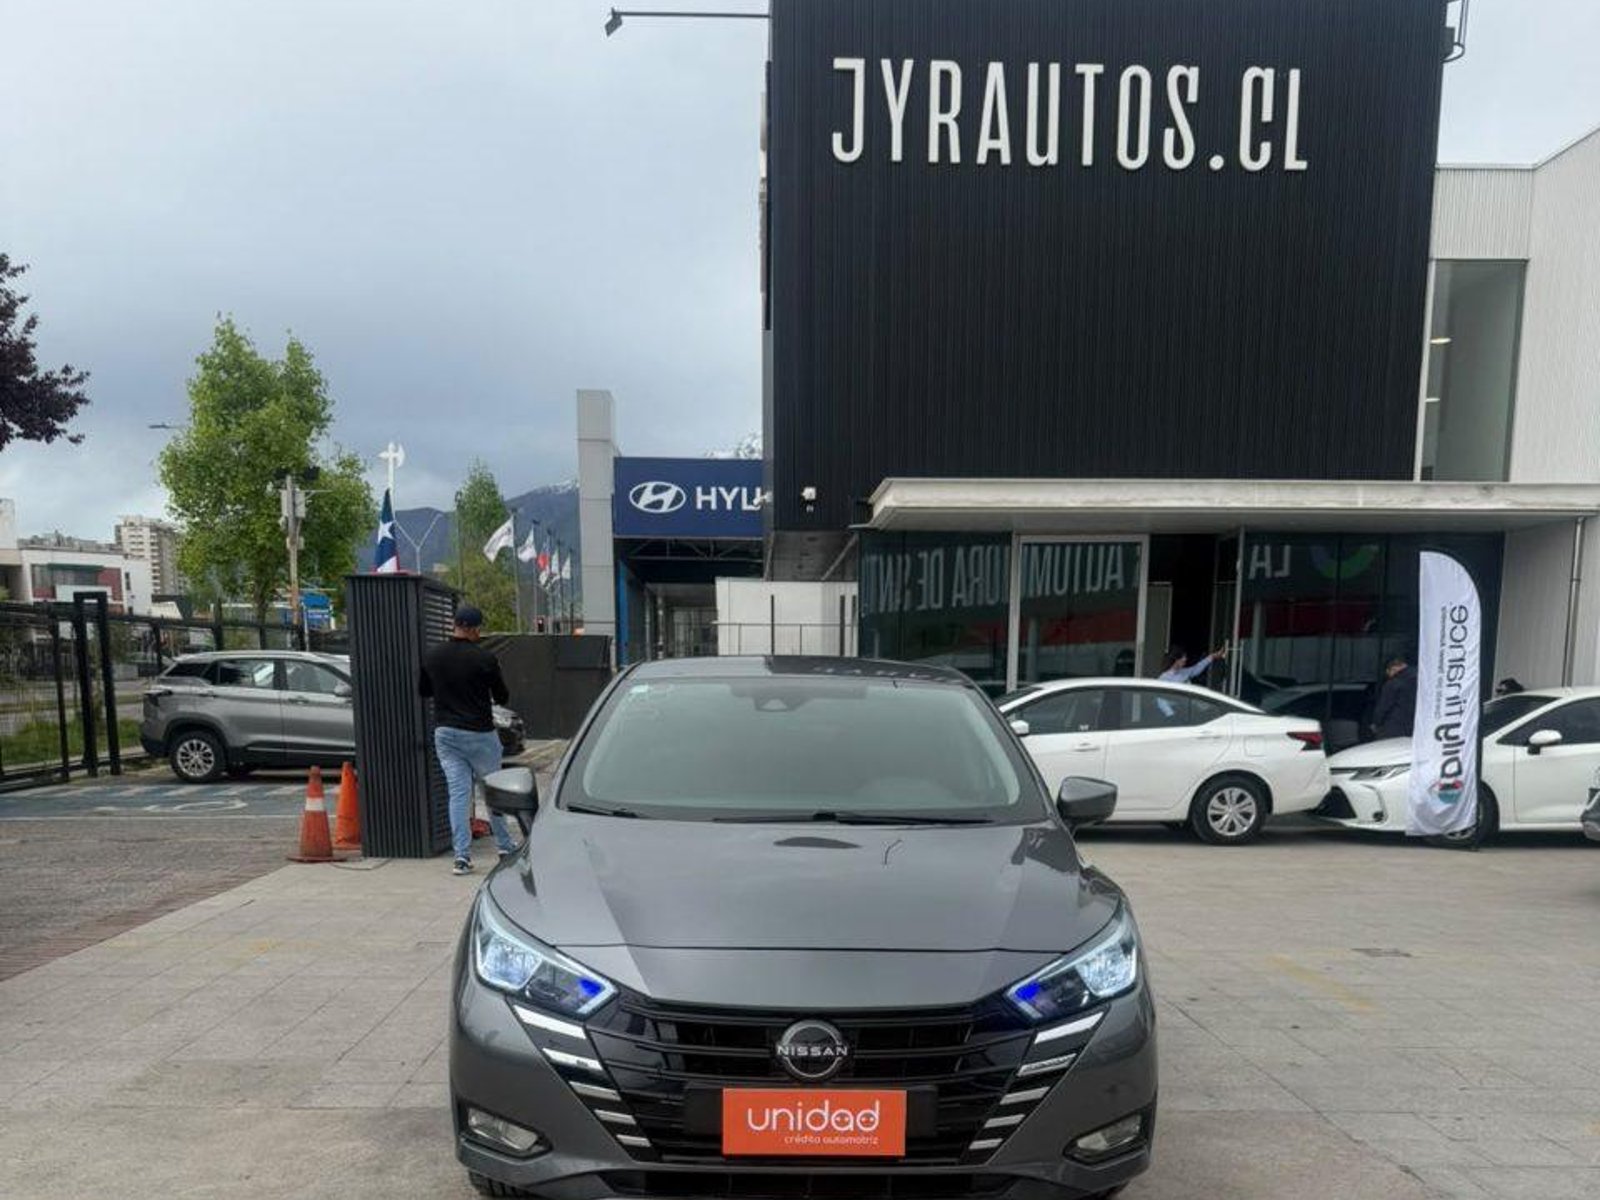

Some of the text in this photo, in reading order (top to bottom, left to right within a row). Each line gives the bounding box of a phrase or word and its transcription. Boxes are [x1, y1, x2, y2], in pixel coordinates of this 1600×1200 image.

[831, 57, 1309, 171] JYRAUTOS.CL
[776, 1045, 848, 1057] NISSAN
[747, 1099, 881, 1131] unidad
[822, 1134, 879, 1145] automotriz
